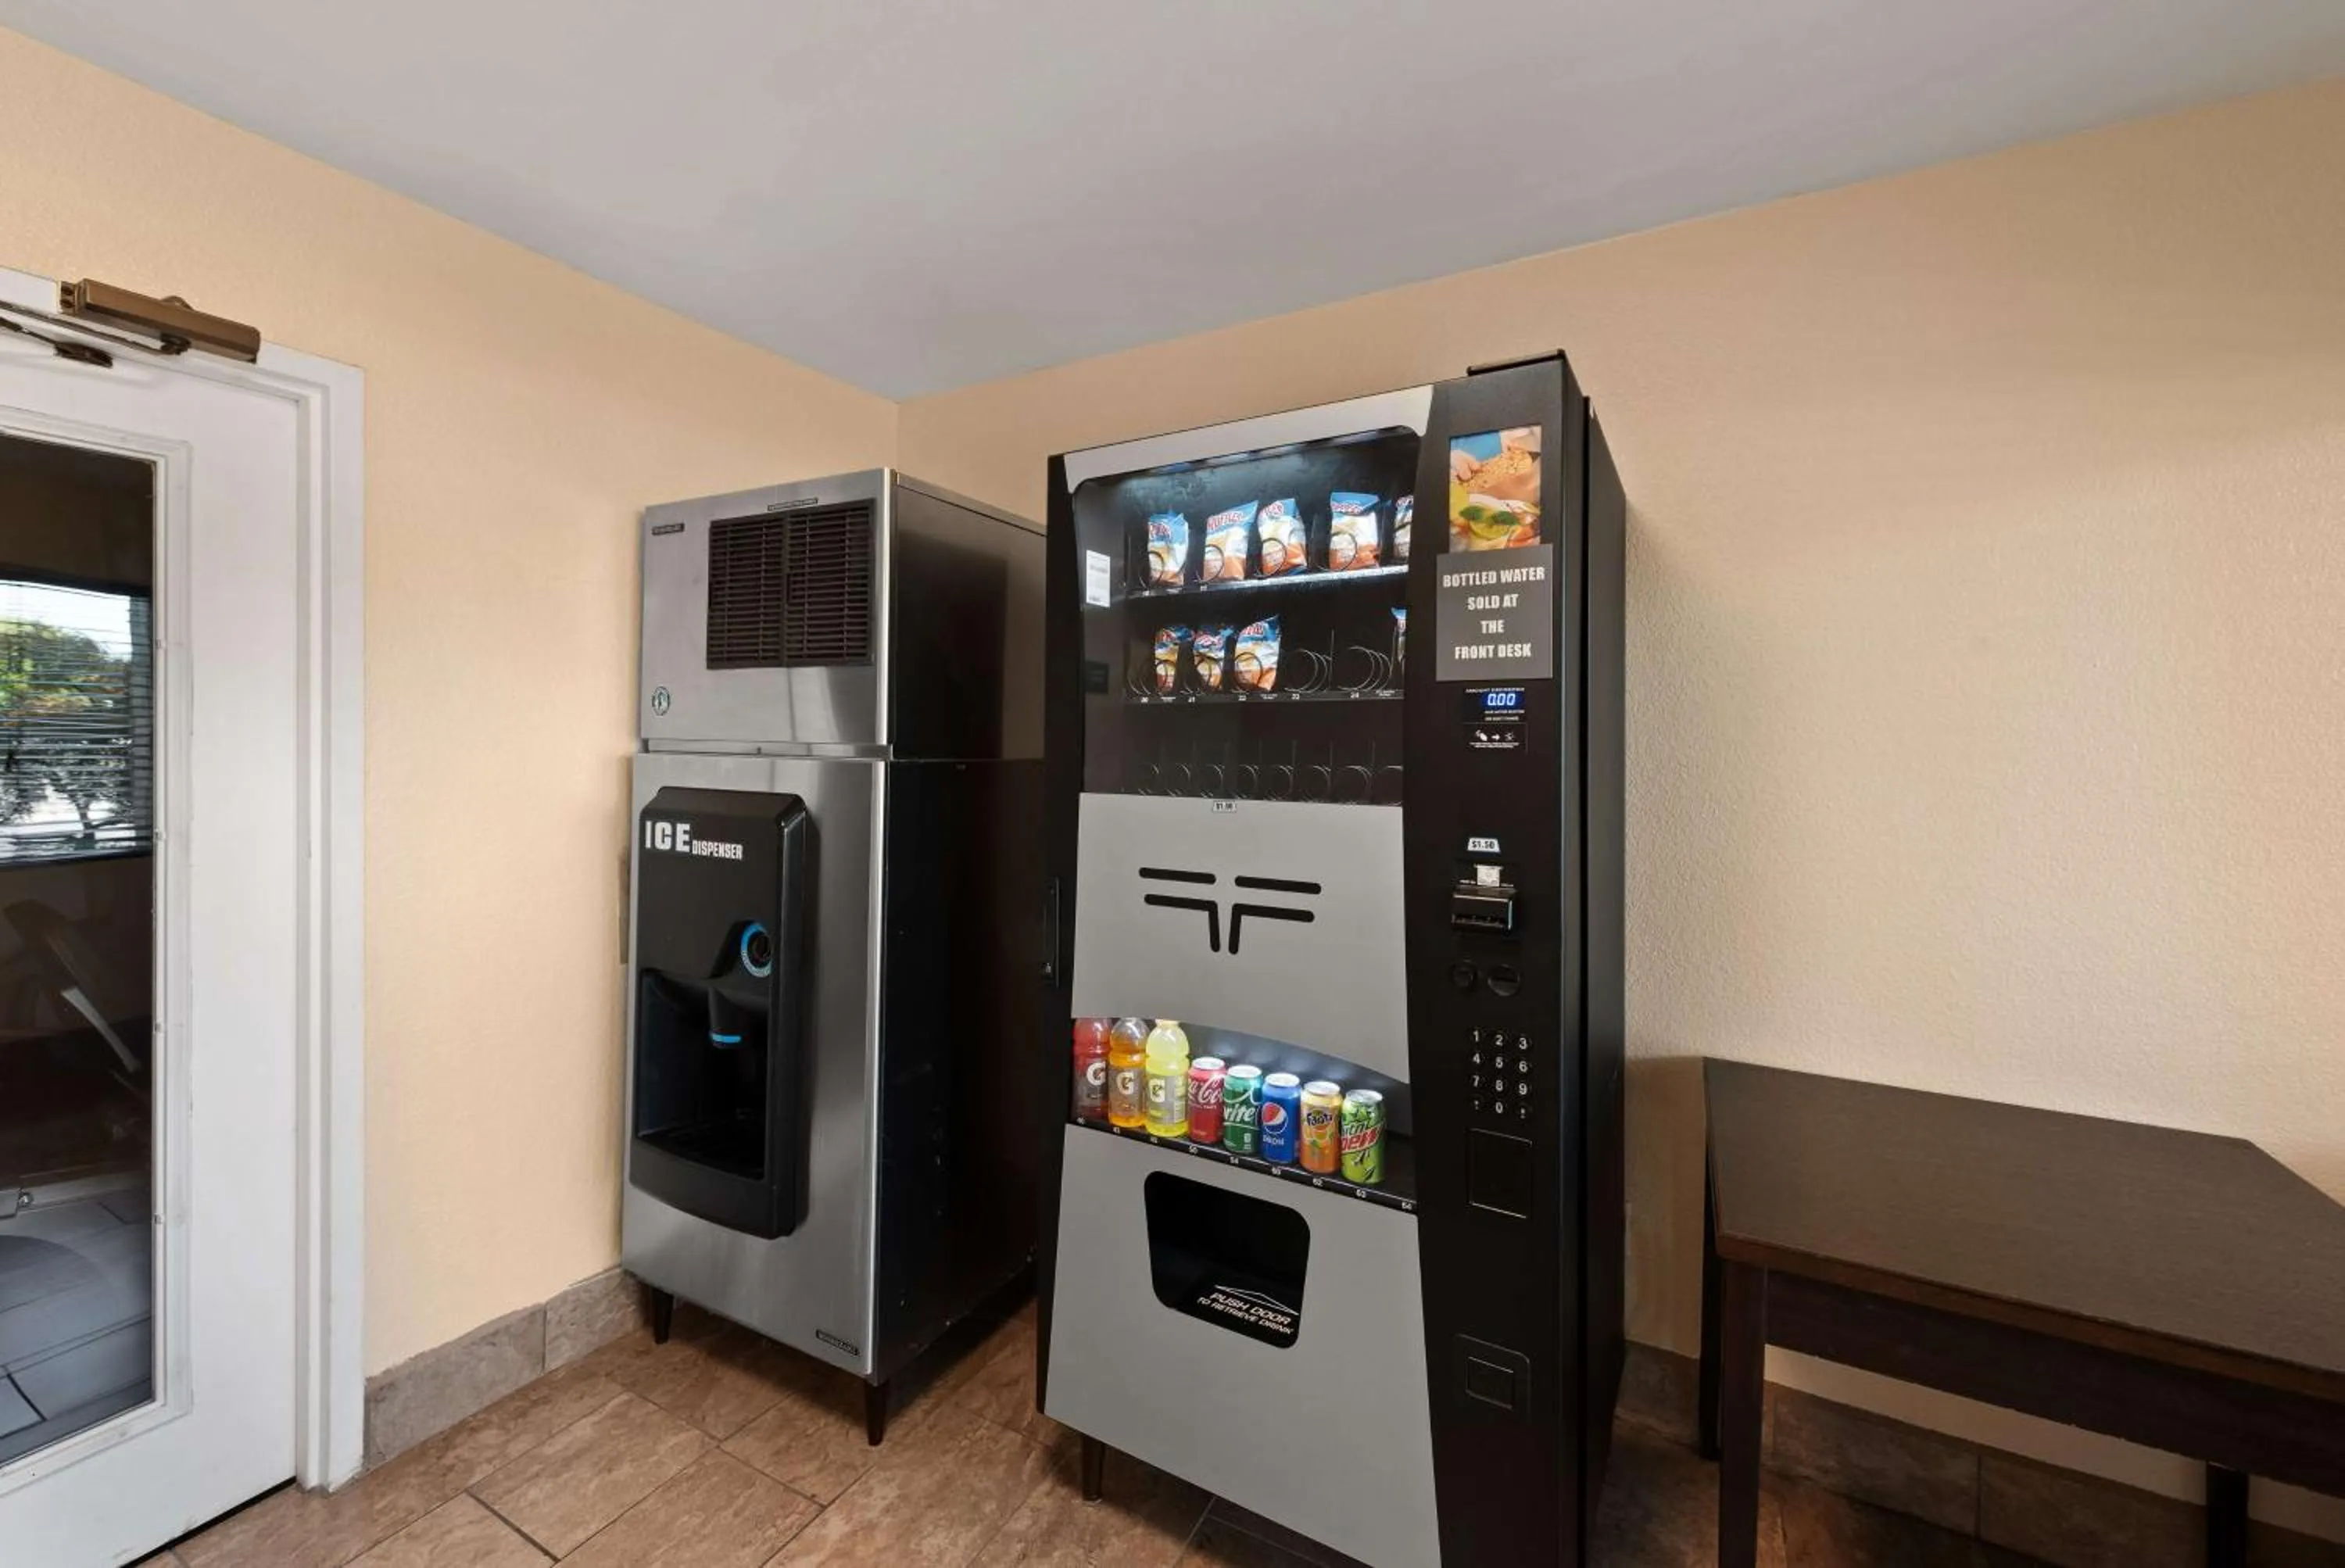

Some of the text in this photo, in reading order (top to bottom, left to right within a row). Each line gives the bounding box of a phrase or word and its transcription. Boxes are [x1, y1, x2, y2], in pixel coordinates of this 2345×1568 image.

[1442, 567, 1545, 588] BOTTLED WATER
[1467, 594, 1519, 610] SOLD AT
[1480, 620, 1505, 634] THE
[1455, 643, 1531, 659] FRONT DESK
[645, 820, 743, 860] ICE DISPENSER
[1473, 1030, 1527, 1050] 1 2 3
[1473, 1053, 1480, 1064] 4
[1519, 1061, 1528, 1072] 6
[1086, 1061, 1106, 1086] G
[1116, 1072, 1134, 1094] G
[1149, 1078, 1165, 1103] G
[1473, 1075, 1527, 1095] 7 8 9
[1495, 1101, 1503, 1114] 0
[1198, 1296, 1211, 1305] TO
[1258, 1319, 1294, 1334] DRINK
[1210, 1292, 1291, 1325] PUSH DOOR
